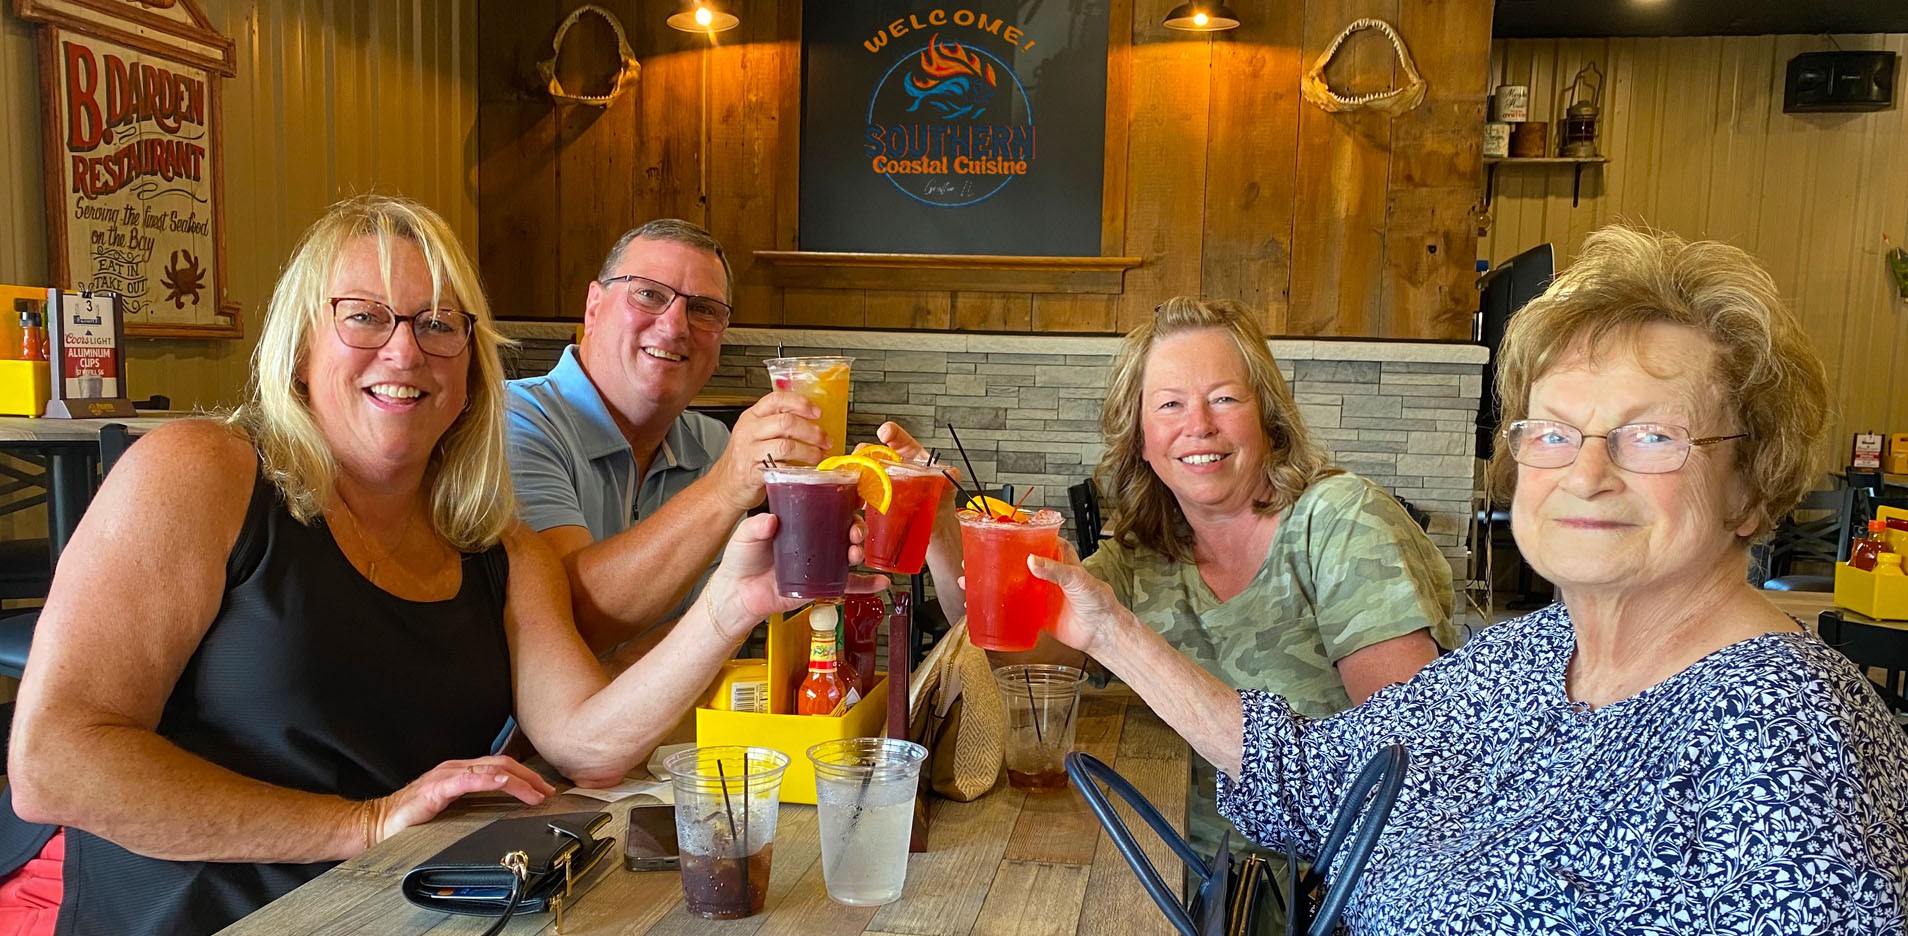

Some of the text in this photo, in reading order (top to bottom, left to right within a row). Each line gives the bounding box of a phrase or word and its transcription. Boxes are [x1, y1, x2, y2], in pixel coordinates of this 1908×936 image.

[863, 9, 1036, 53] WELCOME!
[864, 124, 1037, 160] SOUTHERN
[71, 137, 205, 200] RESTAURANT
[872, 155, 1028, 175] Coastal Cuisine
[75, 196, 209, 236] Serving the finest Seafood
[91, 225, 156, 263] on the Bay
[98, 259, 140, 277] EAT IN
[94, 276, 148, 294] TAKE OUT
[86, 300, 93, 312] 3
[65, 333, 112, 345] Coors LIGHT
[68, 348, 111, 358] ALUMINUM
[80, 358, 100, 368] CUPS
